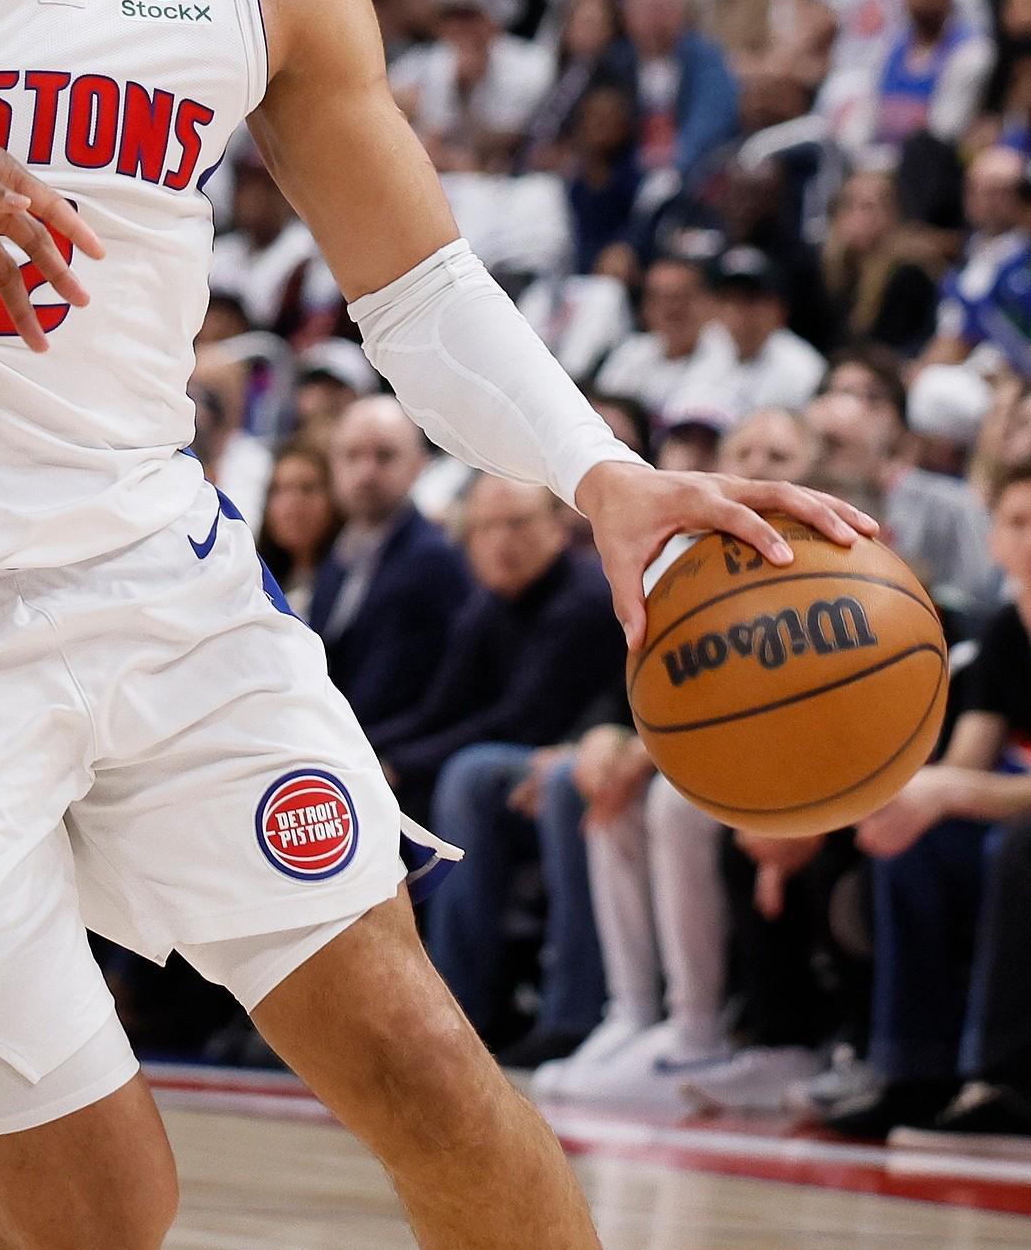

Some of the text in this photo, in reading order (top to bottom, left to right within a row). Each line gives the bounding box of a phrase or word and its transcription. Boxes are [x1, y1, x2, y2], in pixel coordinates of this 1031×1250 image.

[121, 0, 212, 22] StockX
[661, 595, 878, 687] Wilson
[275, 800, 339, 830] DETROIT
[278, 818, 344, 848] PISTONS
